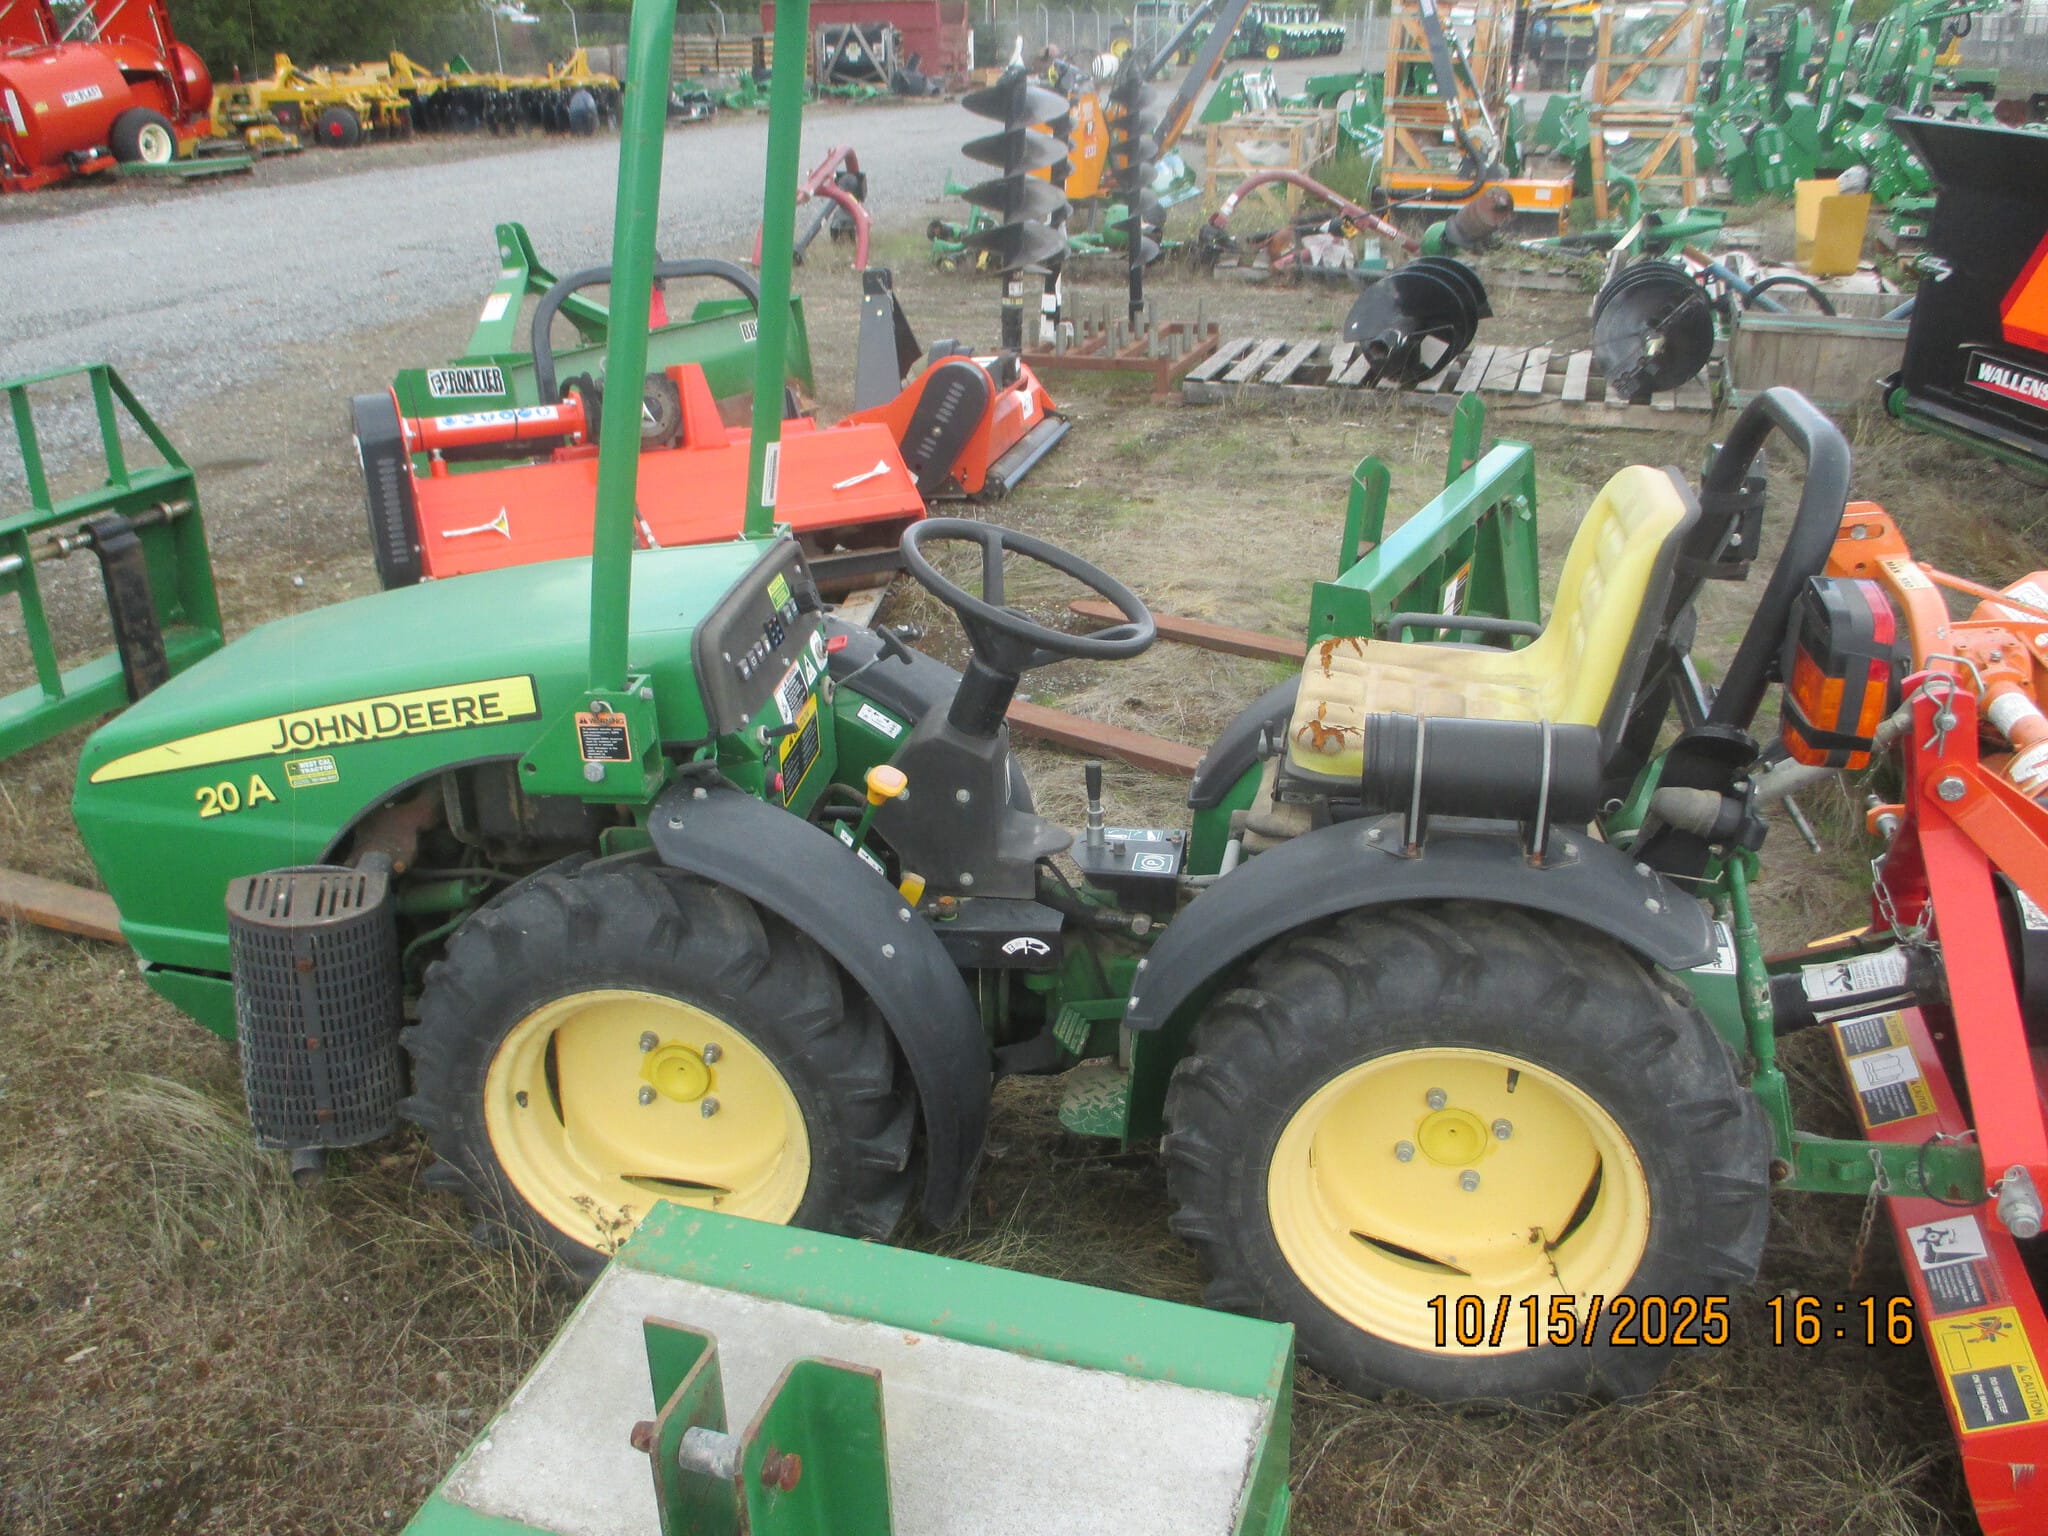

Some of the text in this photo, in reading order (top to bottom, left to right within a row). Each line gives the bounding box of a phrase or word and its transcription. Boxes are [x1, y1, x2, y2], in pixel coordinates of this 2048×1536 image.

[440, 367, 504, 394] FRONTIER
[271, 692, 505, 751] JOHN DEERE
[300, 765, 334, 774] TRACTOR
[195, 773, 278, 818] 20 A
[1998, 1397, 2009, 1415] STEP
[2021, 1374, 2045, 1417] CAUTION
[1980, 1396, 1994, 1423] MACHINE
